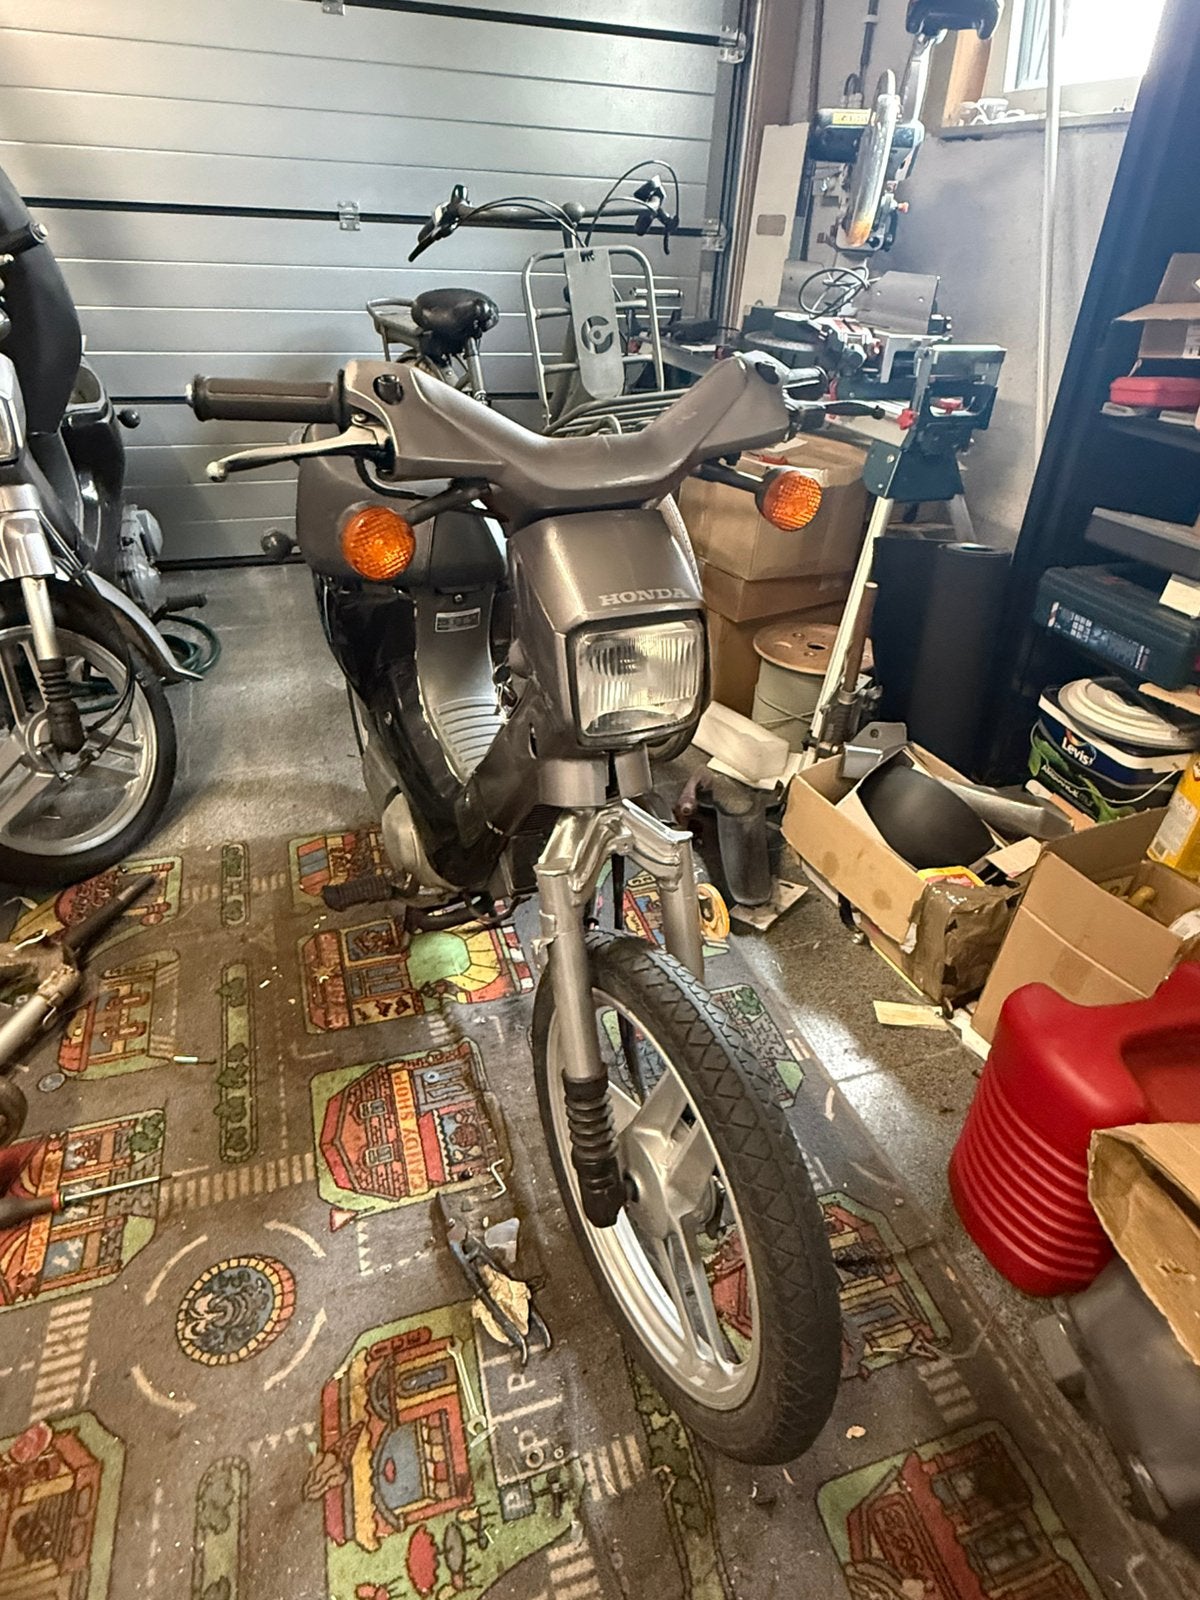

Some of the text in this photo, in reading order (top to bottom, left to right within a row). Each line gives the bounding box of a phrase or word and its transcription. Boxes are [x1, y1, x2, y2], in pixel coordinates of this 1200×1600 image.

[598, 587, 691, 606] HONDA
[393, 1074, 426, 1190] CANDY SHOP
[507, 1373, 537, 1394] P
[518, 1429, 549, 1452] P
